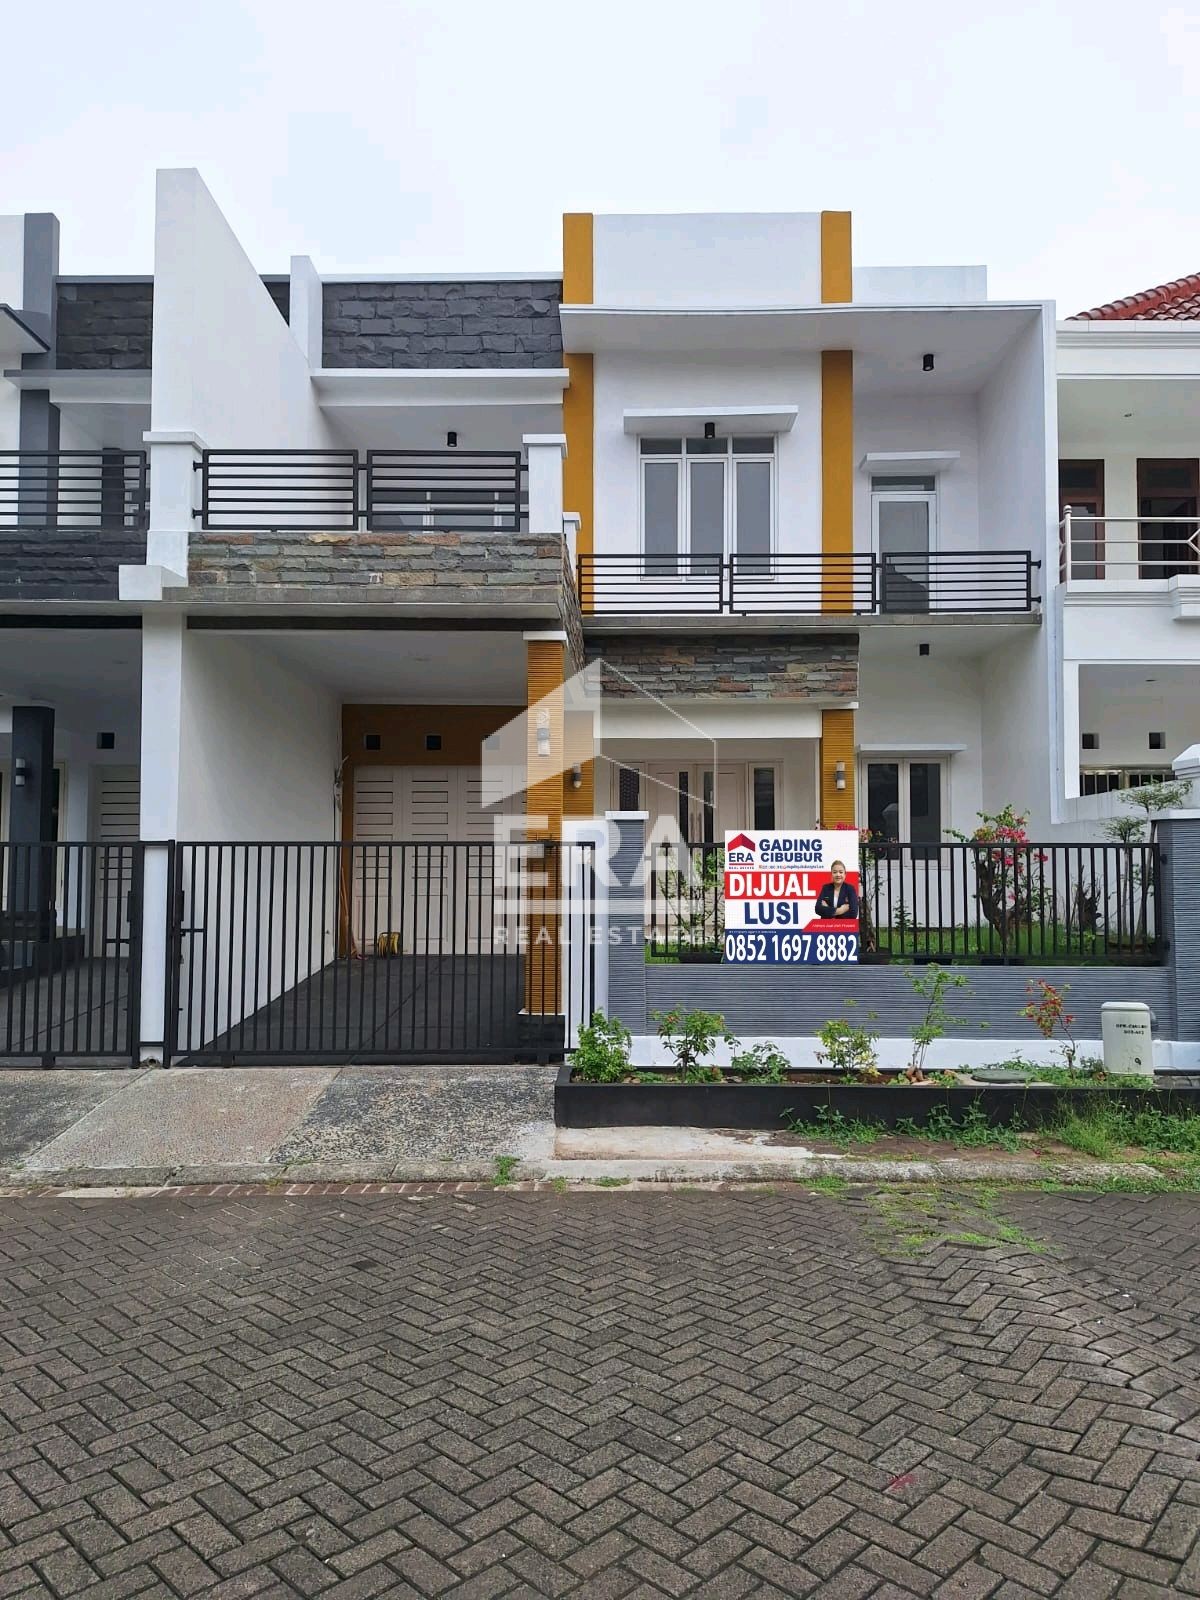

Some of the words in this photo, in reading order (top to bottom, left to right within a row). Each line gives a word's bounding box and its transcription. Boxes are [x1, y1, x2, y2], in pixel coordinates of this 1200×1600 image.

[759, 838, 823, 852] GADING
[729, 853, 755, 863] ERA
[760, 852, 823, 863] CIBUBUR
[729, 873, 817, 897] DIJUAL
[744, 901, 799, 925] LUSI
[726, 934, 767, 962] 0852
[772, 934, 812, 962] 1697
[816, 934, 858, 962] 8882
